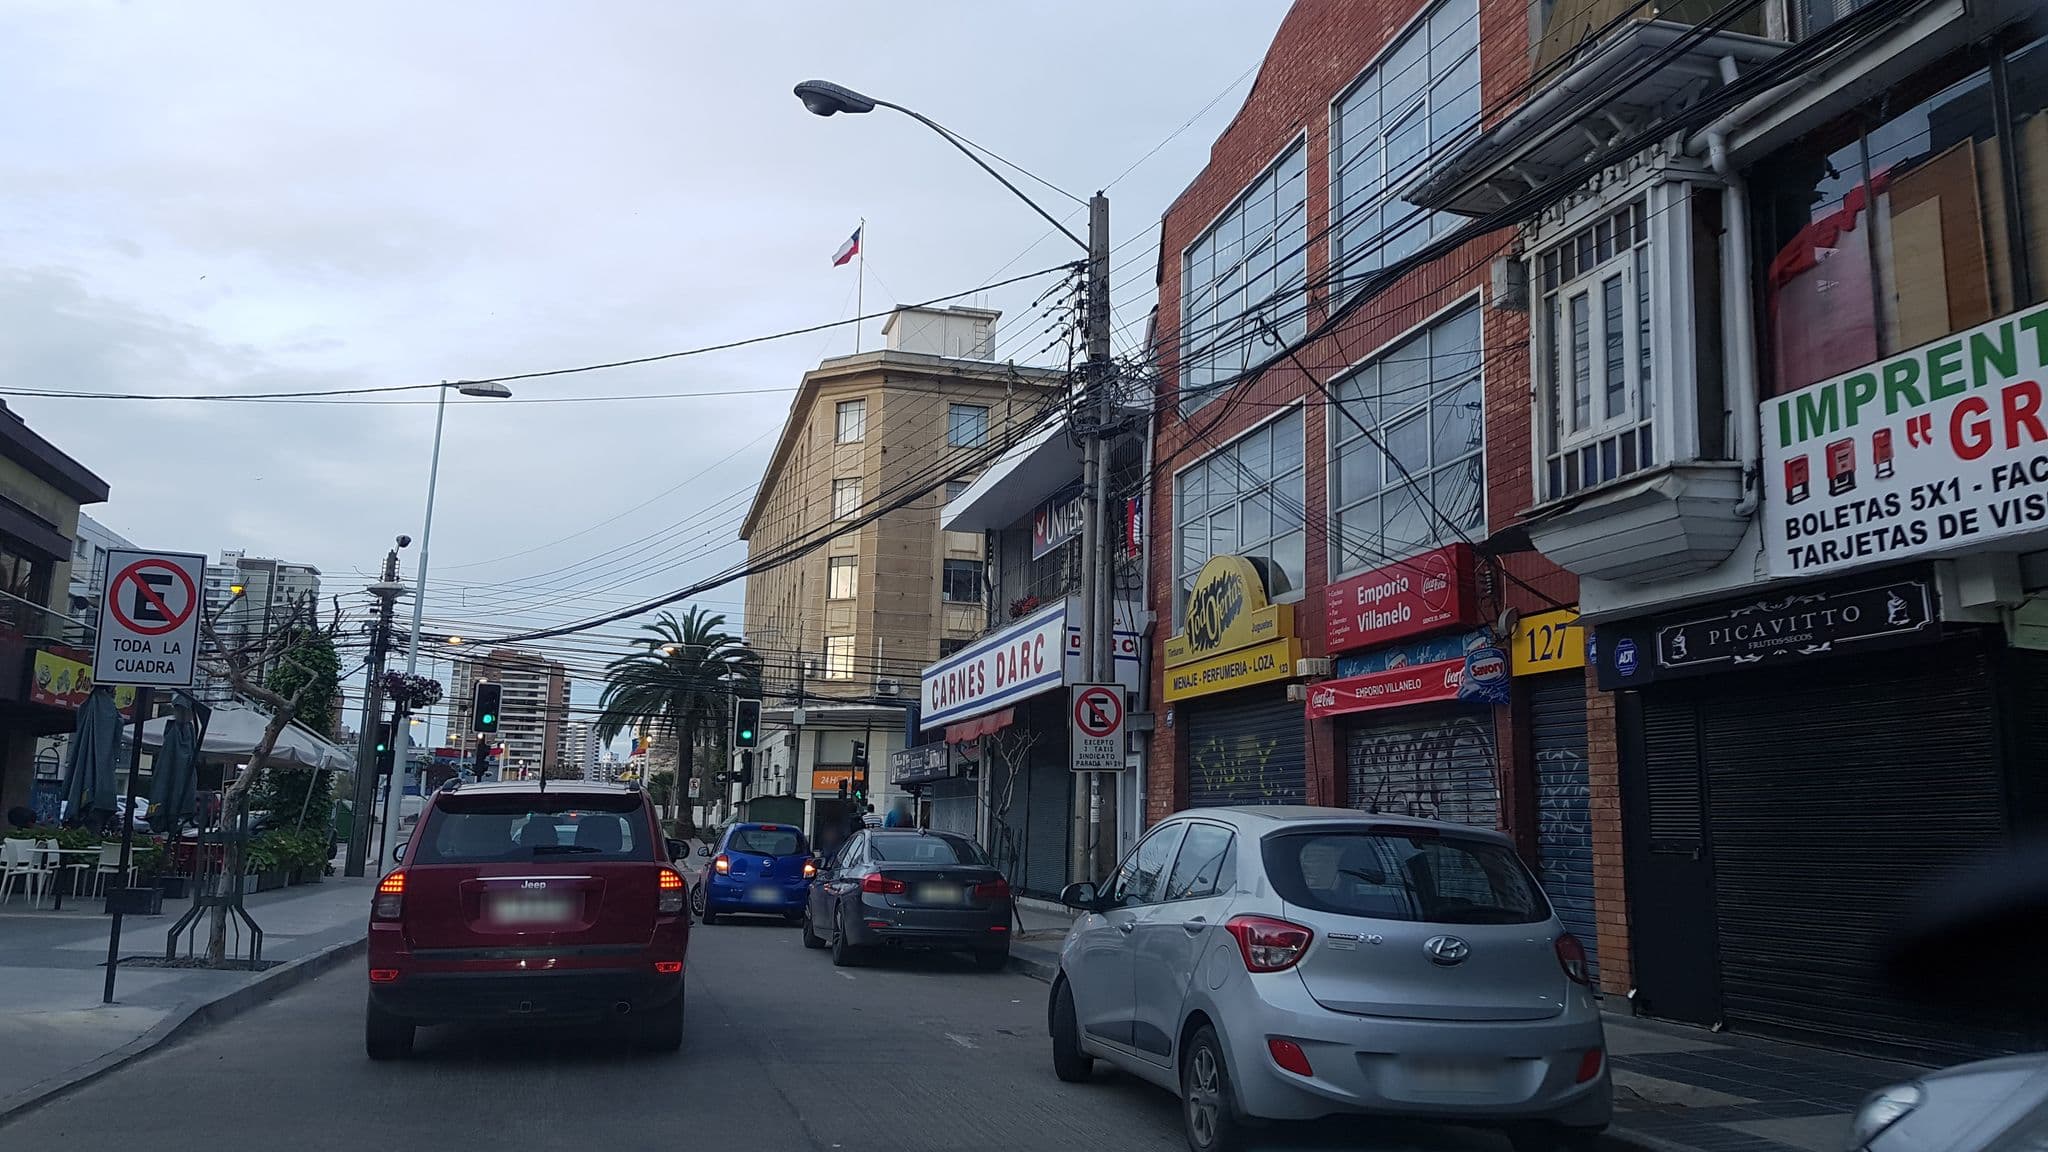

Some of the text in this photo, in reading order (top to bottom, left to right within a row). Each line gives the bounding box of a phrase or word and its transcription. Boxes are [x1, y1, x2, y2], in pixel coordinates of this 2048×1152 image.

[1786, 493, 1901, 540] BOLETAS
[1911, 477, 1961, 511] 5X1
[1788, 492, 2048, 569] TARJETAS DE VIS
[1357, 574, 1409, 606] Emporio
[1357, 601, 1411, 633] Villanelo
[1709, 605, 1860, 645] PICAVITTO
[113, 639, 181, 654] TODA LA
[1526, 623, 1568, 663] 127
[1618, 650, 1635, 665] ADT
[115, 659, 175, 674] CUADRA
[932, 633, 1044, 711] CARNES DARC
[1173, 673, 1198, 691] MENAJE
[1202, 660, 1248, 683] PERFUMERIA
[1253, 654, 1275, 672] LOZA
[1471, 661, 1504, 677] Savory
[1355, 678, 1421, 698] EMPORIO VILLANELO
[521, 880, 547, 890] Jeep
